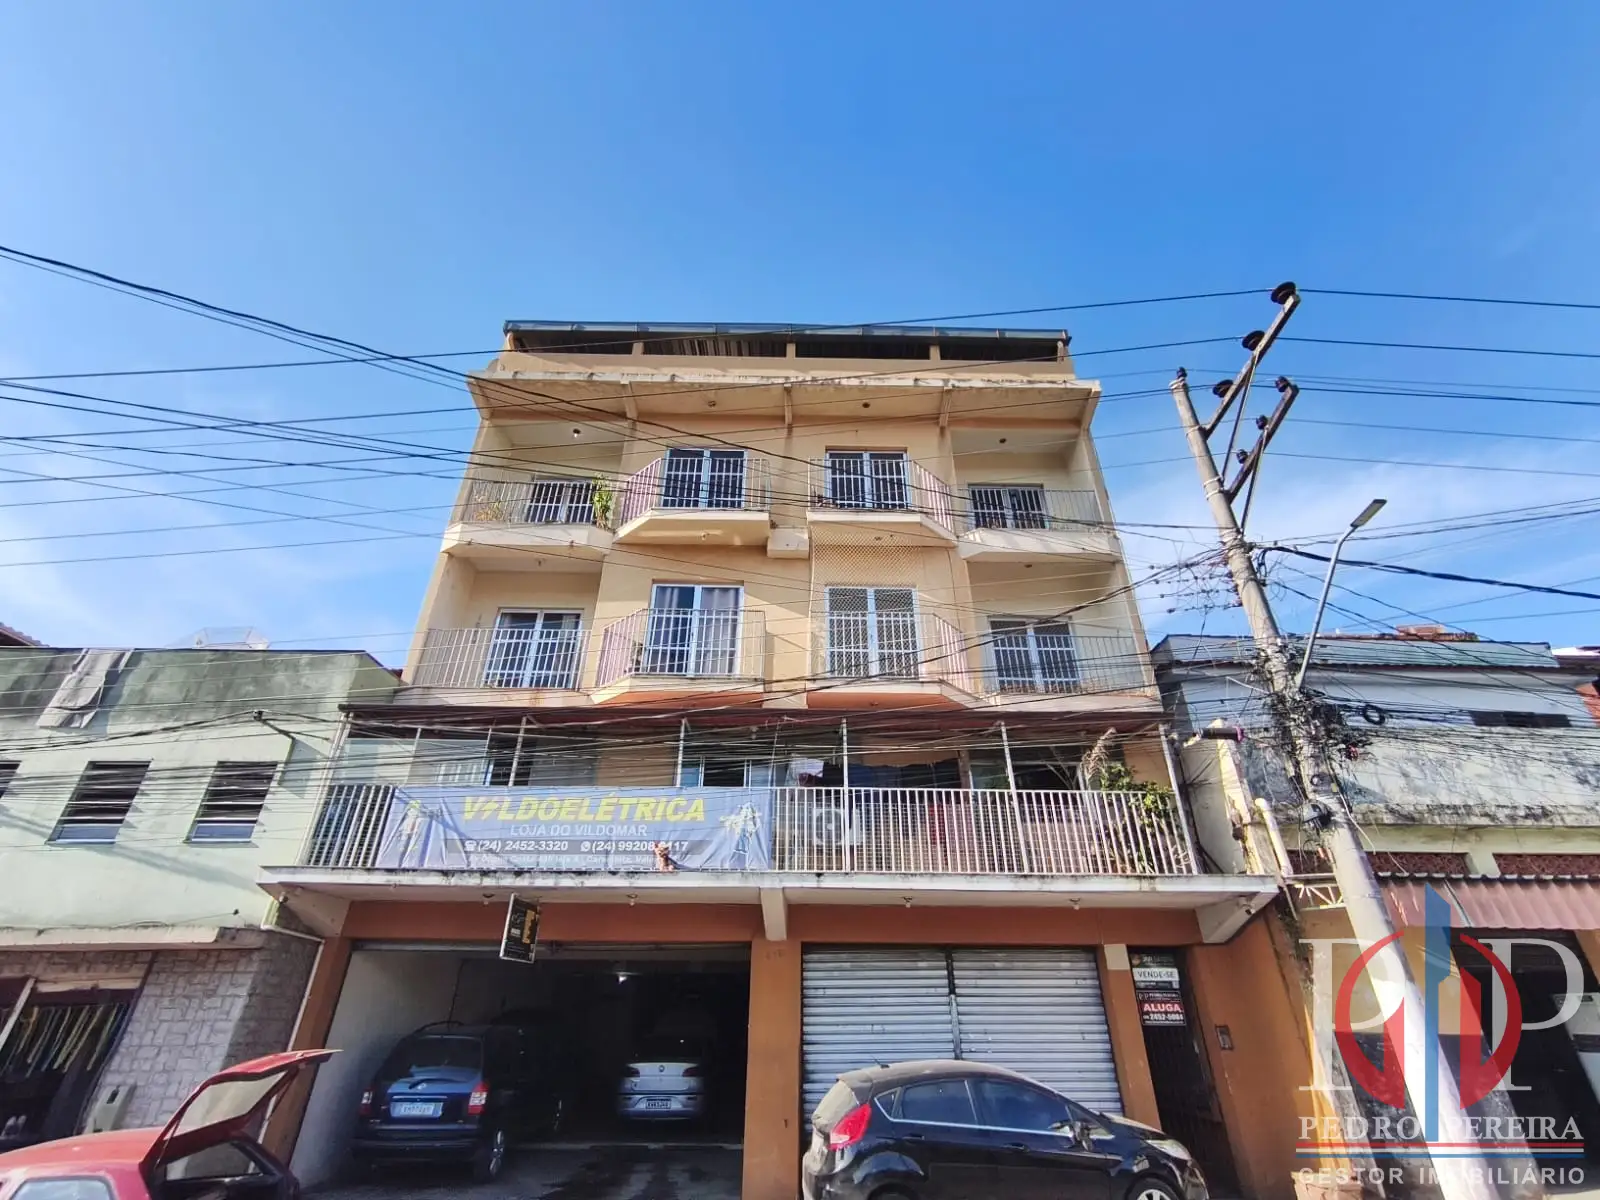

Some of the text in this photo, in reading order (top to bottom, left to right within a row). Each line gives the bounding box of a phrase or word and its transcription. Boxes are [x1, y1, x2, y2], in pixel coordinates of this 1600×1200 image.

[510, 824, 648, 837] LOJA DO VILDOMAR
[478, 840, 569, 853] (24) 2452-3320
[592, 841, 689, 853] (24) 99208117
[1137, 970, 1176, 978] VENDE-SE
[1143, 1003, 1181, 1012] ALUGA
